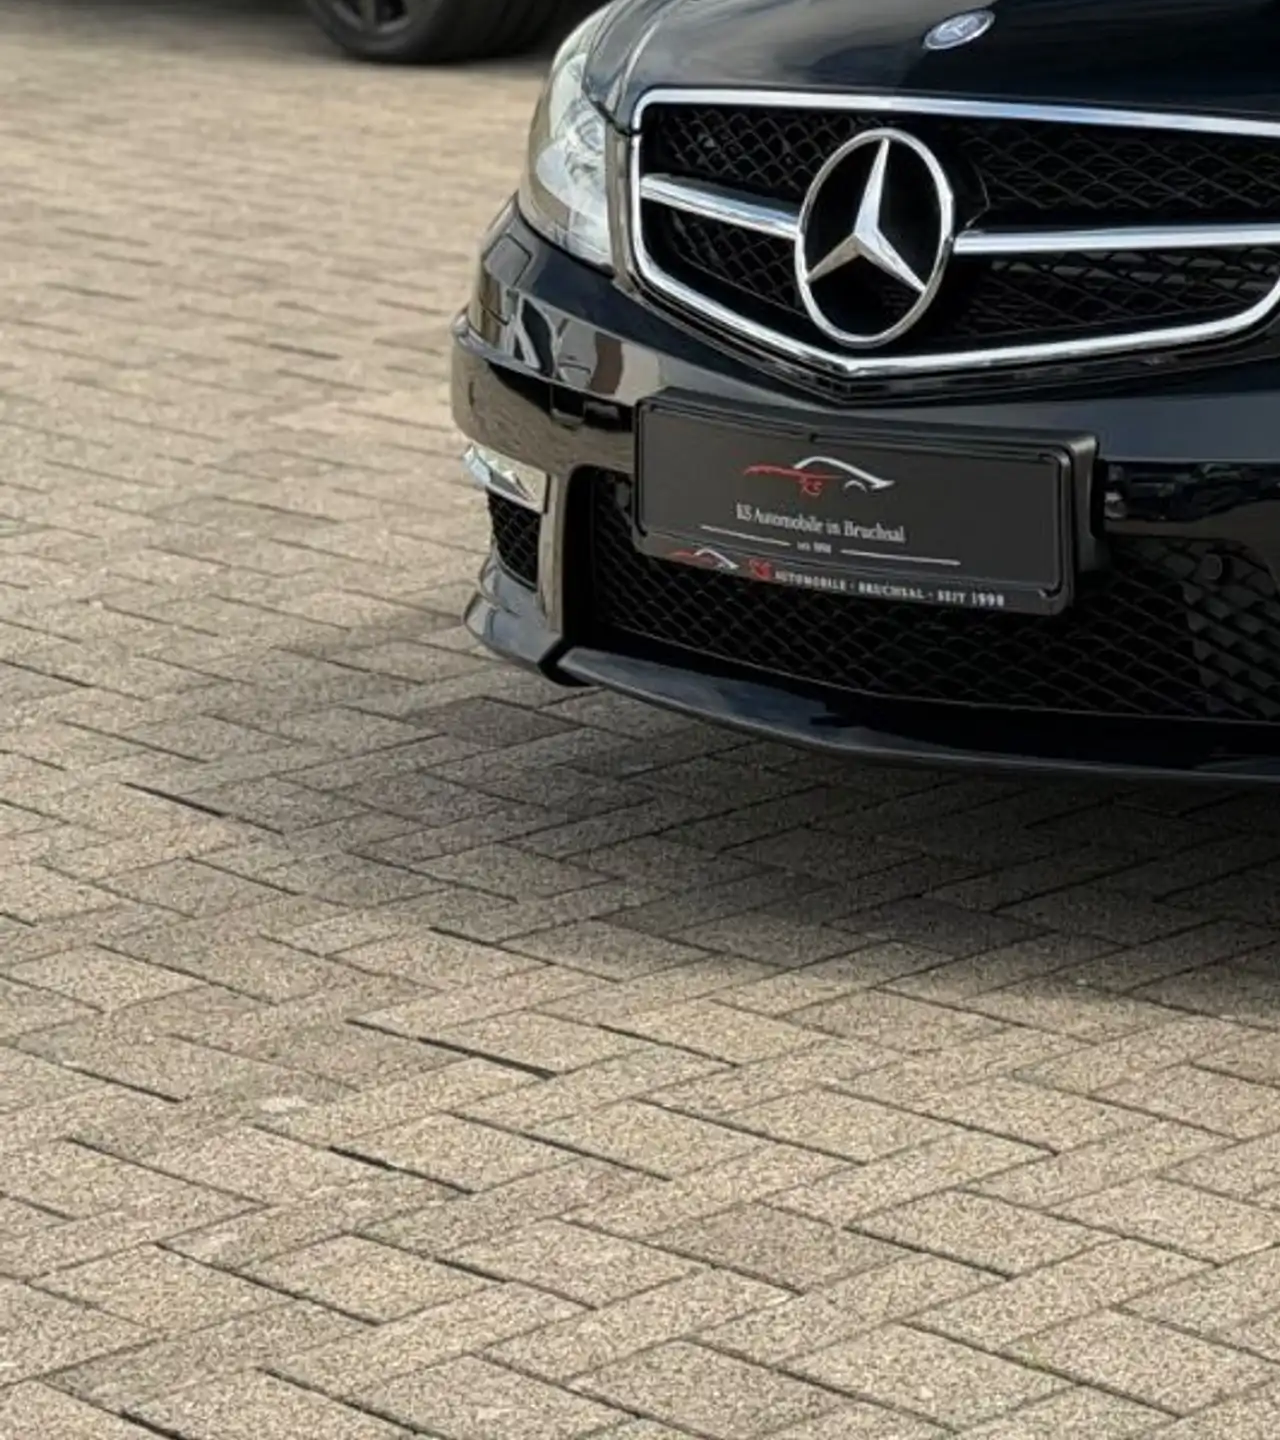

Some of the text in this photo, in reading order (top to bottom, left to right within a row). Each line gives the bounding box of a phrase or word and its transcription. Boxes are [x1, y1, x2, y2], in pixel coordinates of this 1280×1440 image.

[754, 509, 824, 534] Automobile
[826, 519, 841, 535] in
[844, 520, 907, 544] Bruchsal
[774, 569, 846, 592] AUTOMOBILE
[857, 581, 924, 600] BRUCHSAL
[937, 589, 966, 604] SEIT
